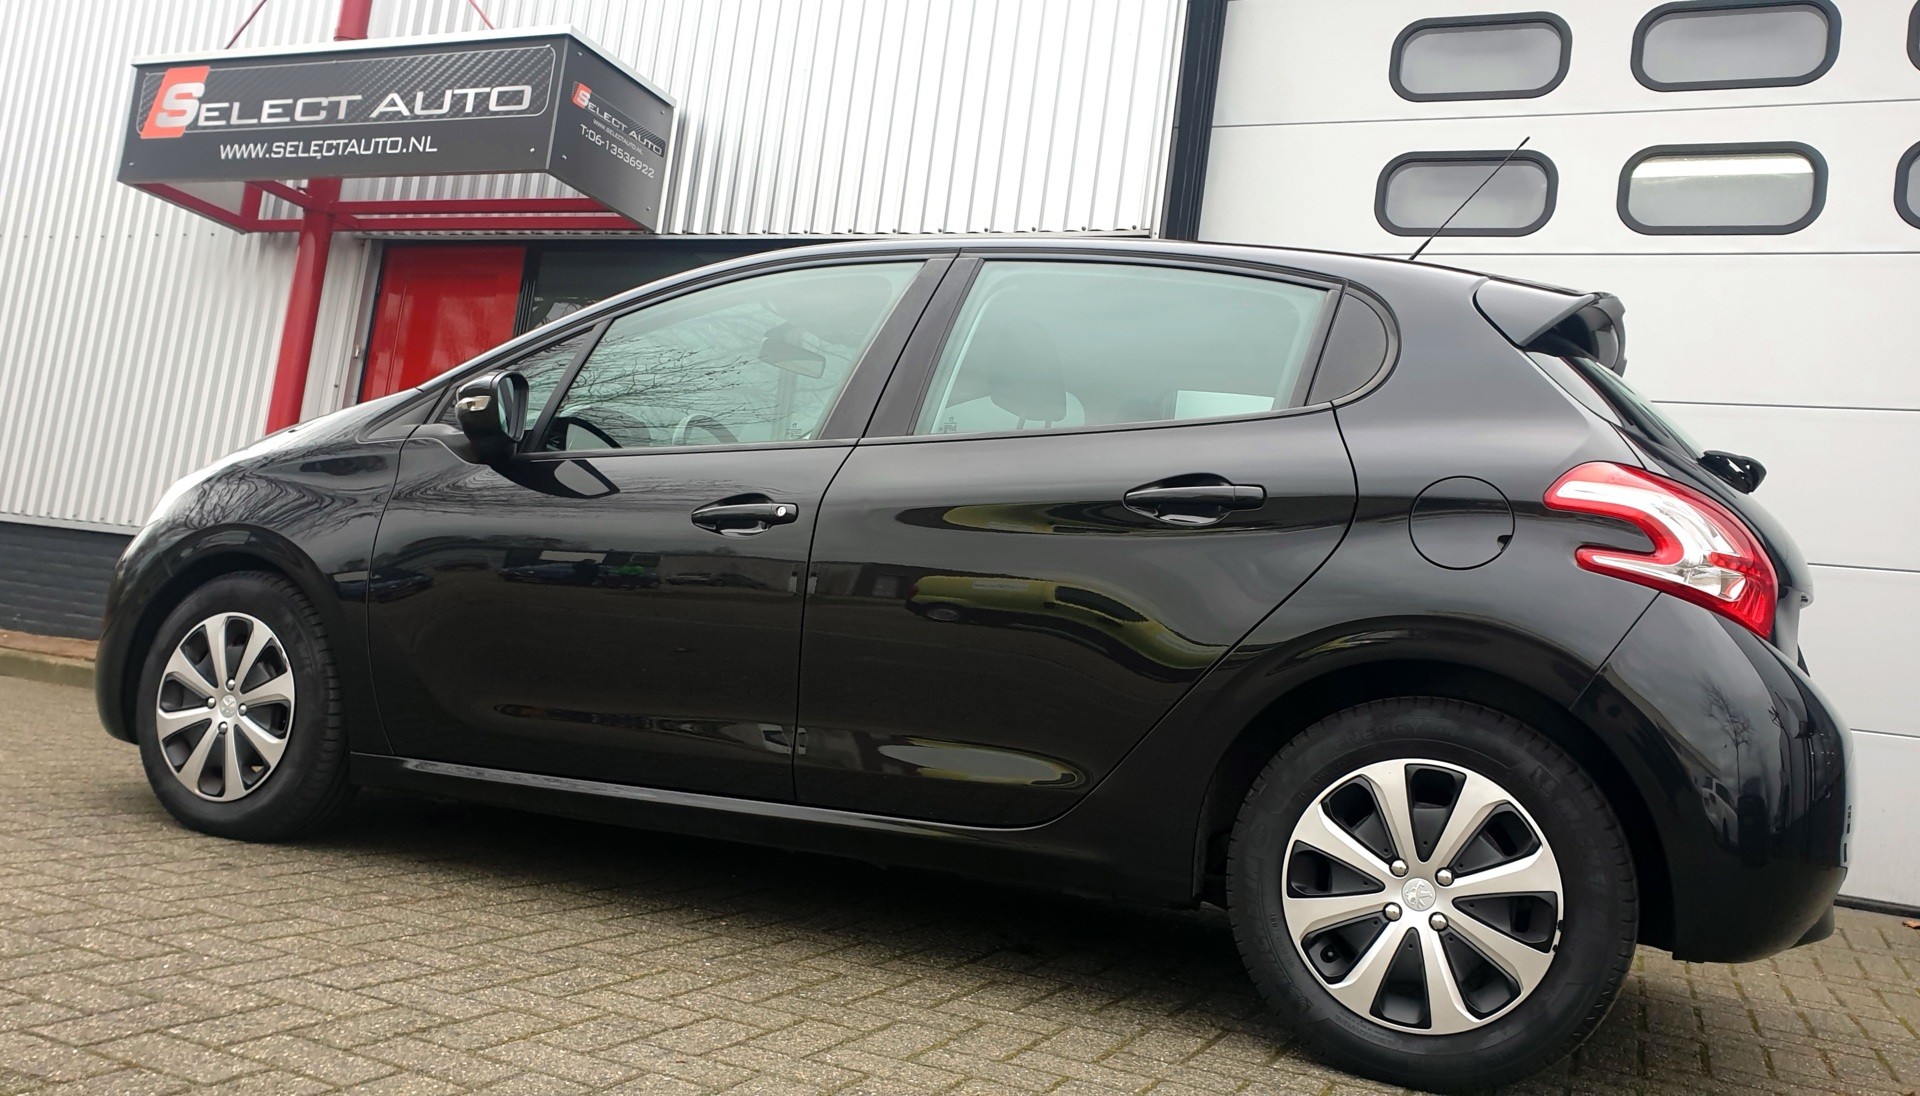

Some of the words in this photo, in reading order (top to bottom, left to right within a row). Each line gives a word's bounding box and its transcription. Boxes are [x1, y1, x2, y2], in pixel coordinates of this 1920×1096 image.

[156, 82, 362, 128] SELECT
[369, 84, 532, 119] AUTO
[576, 89, 628, 131] SELECT
[629, 130, 663, 156] AUTO
[219, 135, 438, 160] WWW.SELECTAUTO.NL
[580, 123, 655, 179] T:06-13536922
